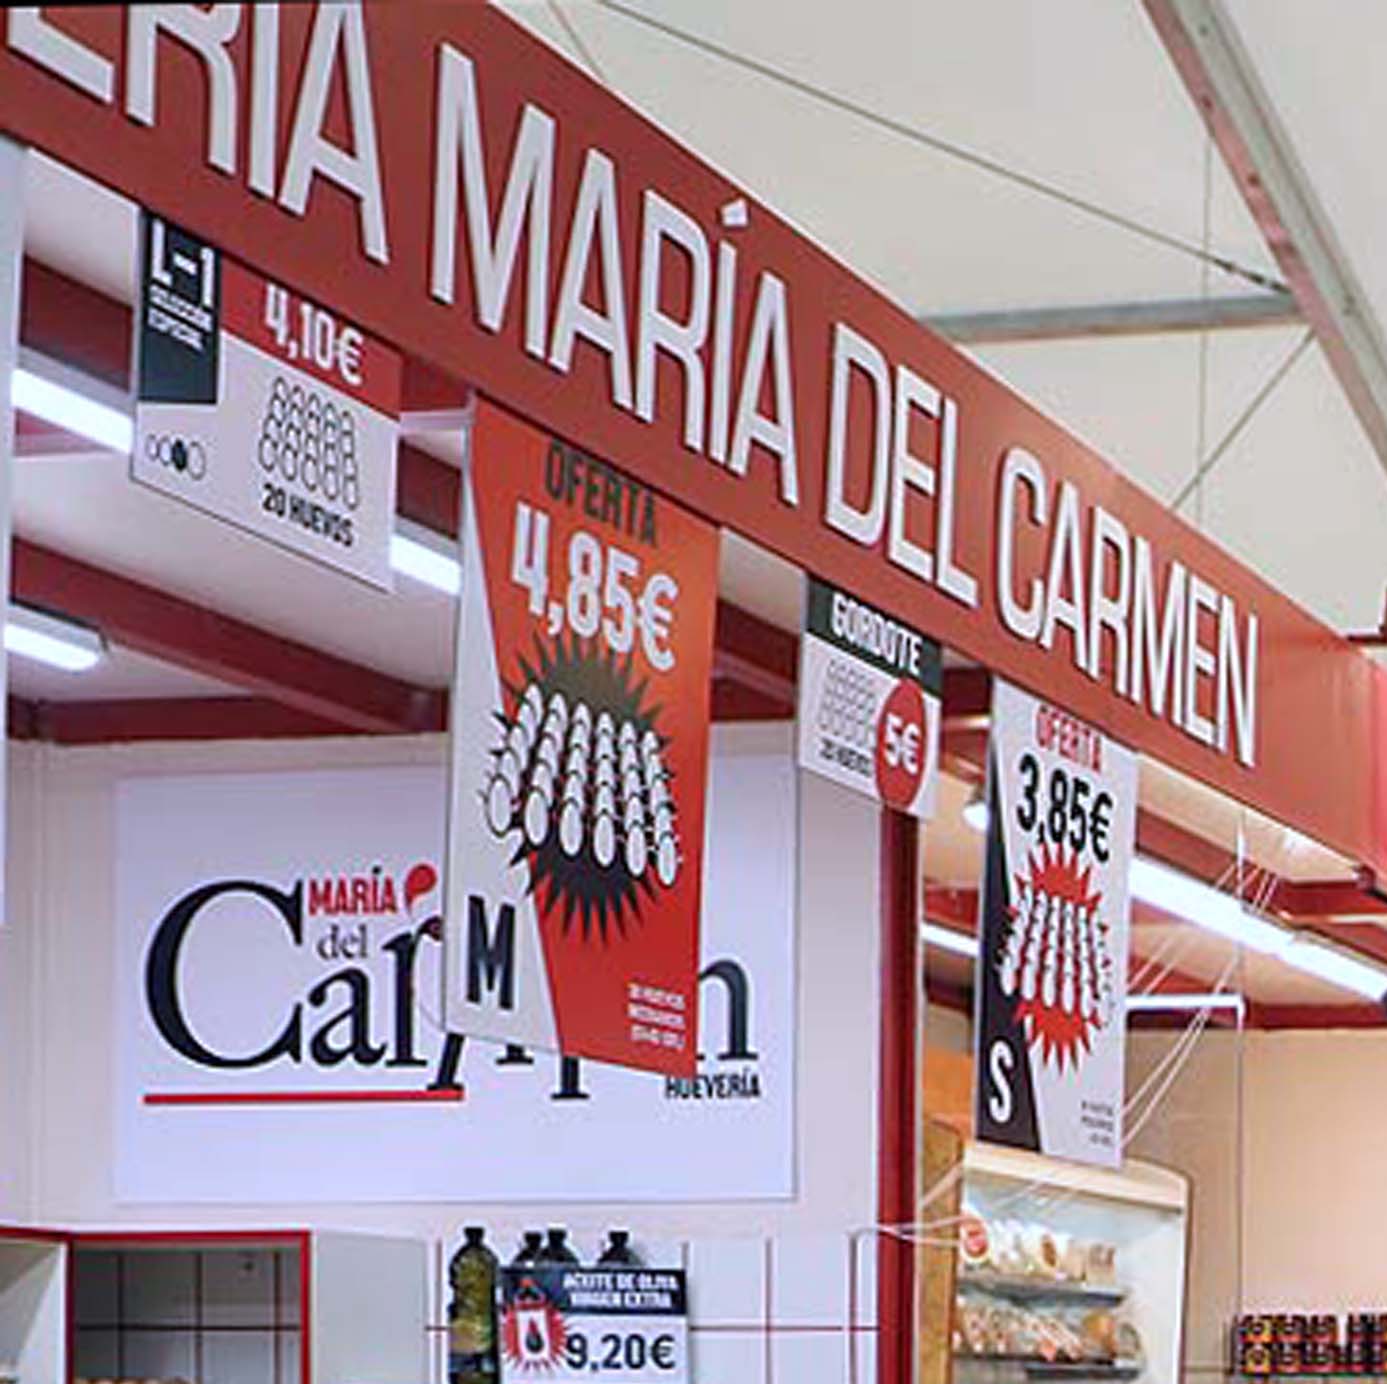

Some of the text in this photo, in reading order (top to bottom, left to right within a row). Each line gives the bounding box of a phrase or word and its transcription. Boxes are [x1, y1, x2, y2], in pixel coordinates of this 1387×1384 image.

[265, 284, 366, 386] 4,10€
[430, 42, 798, 507] MARÍA
[825, 322, 978, 609] DEL
[998, 446, 1257, 769] CARMEN
[263, 482, 354, 548] 20 HUEVOS
[545, 436, 658, 547] OFERTA
[512, 500, 679, 671] 4,85€
[831, 592, 924, 675] GORDOTE
[884, 712, 922, 776] 5€
[1016, 754, 1114, 863] 3,85€
[308, 866, 397, 915] MARÍA
[316, 924, 370, 960] del
[466, 895, 516, 1011] M
[989, 1040, 1015, 1123] S
[563, 1272, 613, 1290] ACEITE
[616, 1272, 636, 1290] DE
